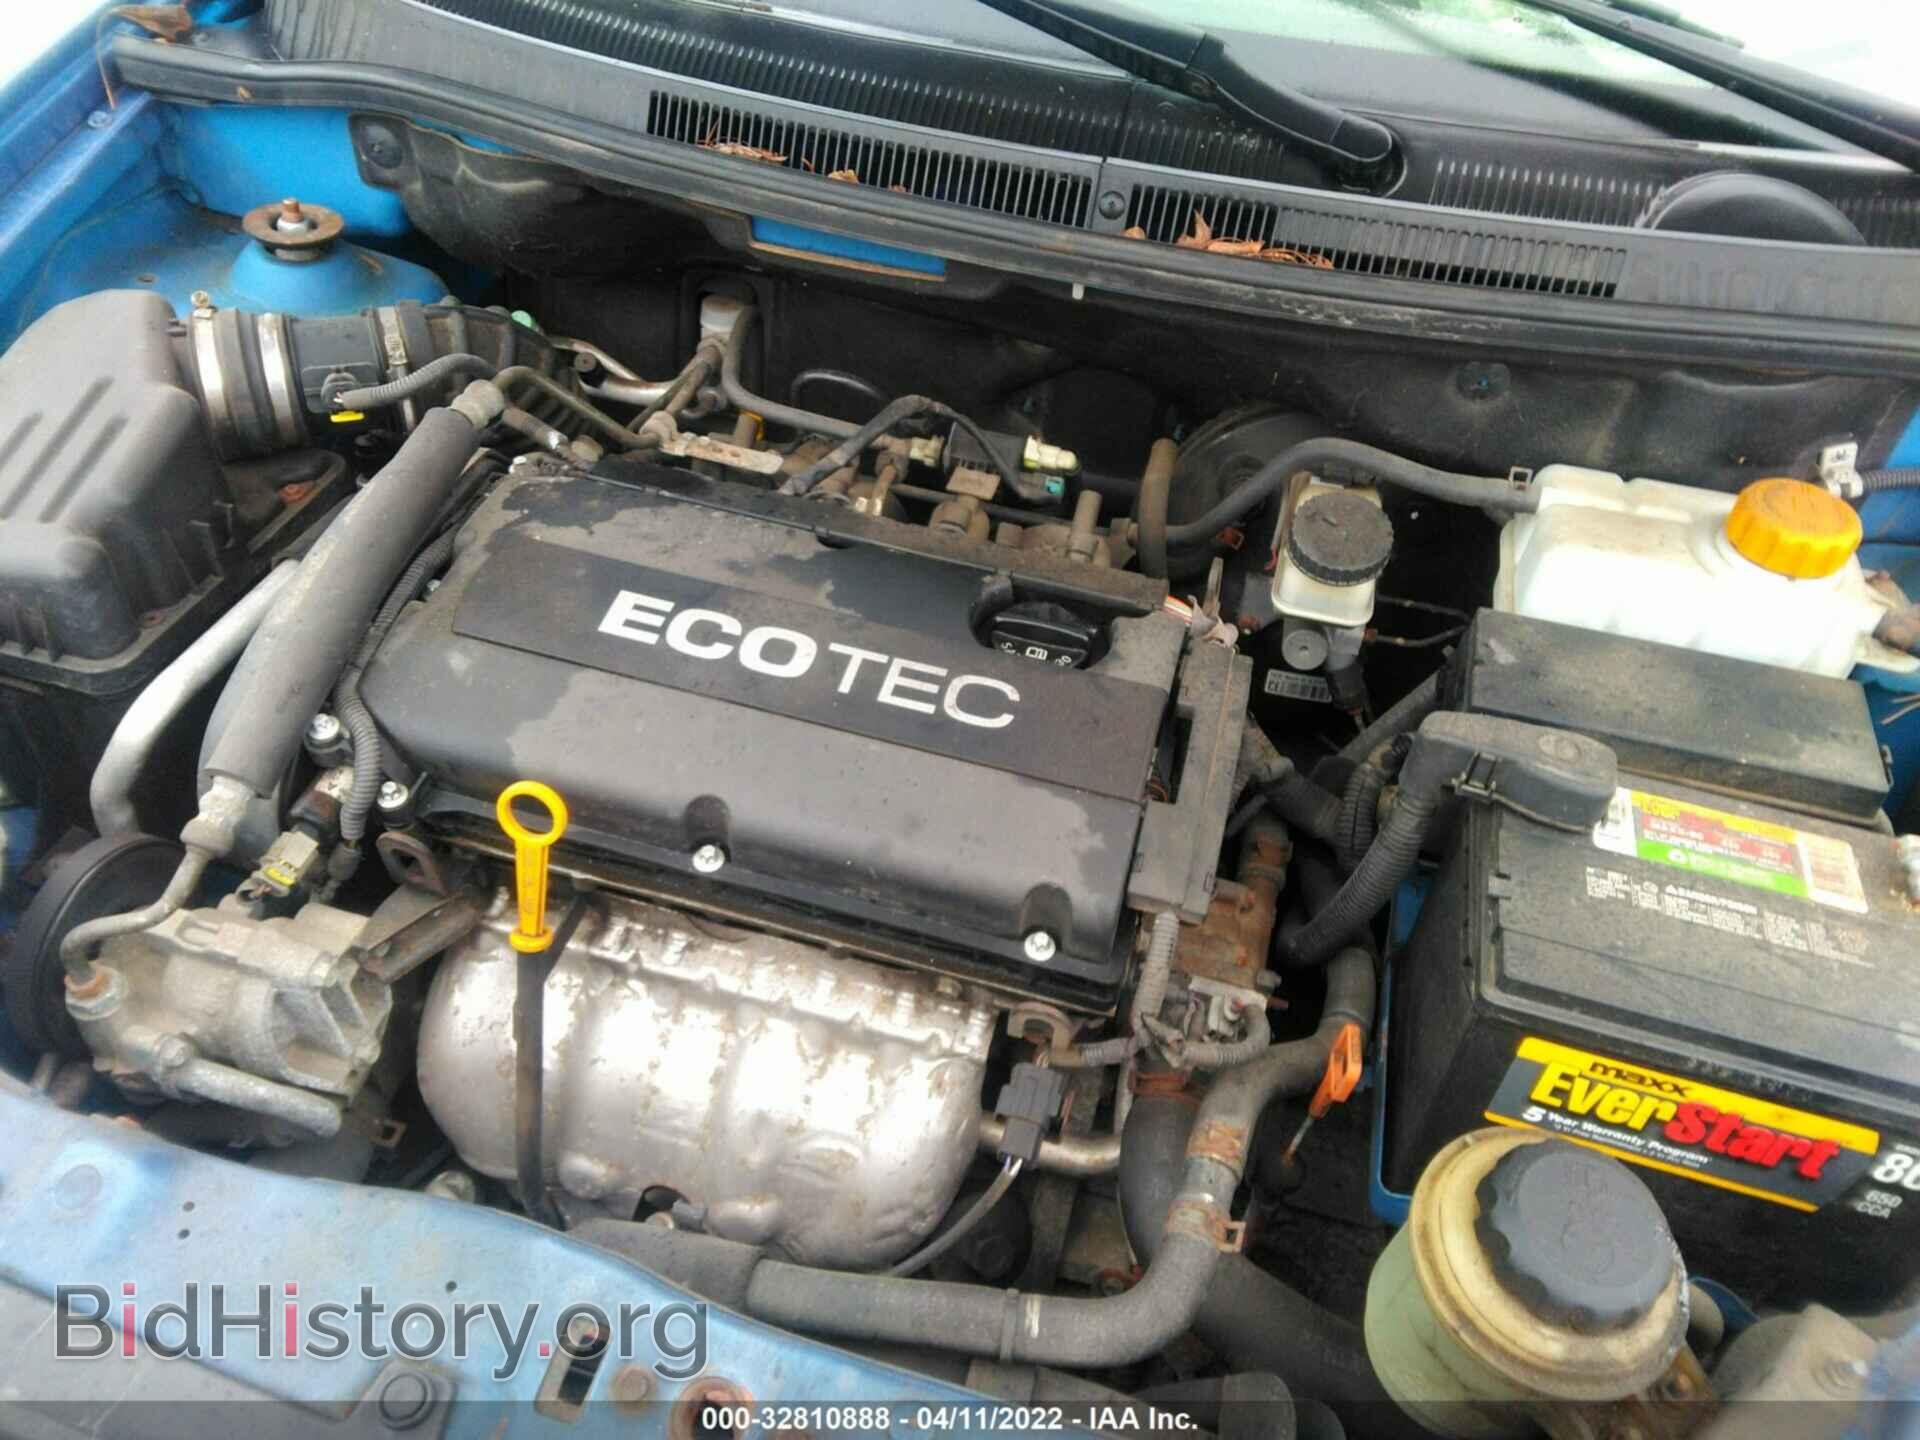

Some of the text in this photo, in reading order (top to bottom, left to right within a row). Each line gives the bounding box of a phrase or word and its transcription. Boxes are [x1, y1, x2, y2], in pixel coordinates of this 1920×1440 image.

[598, 589, 1020, 728] ECOTEC
[1522, 1105, 1547, 1123] 5
[1548, 1111, 1581, 1127] Year
[1581, 1121, 1646, 1147] Warranty
[1647, 1138, 1709, 1164] Program
[1531, 1062, 1841, 1180] EverStart
